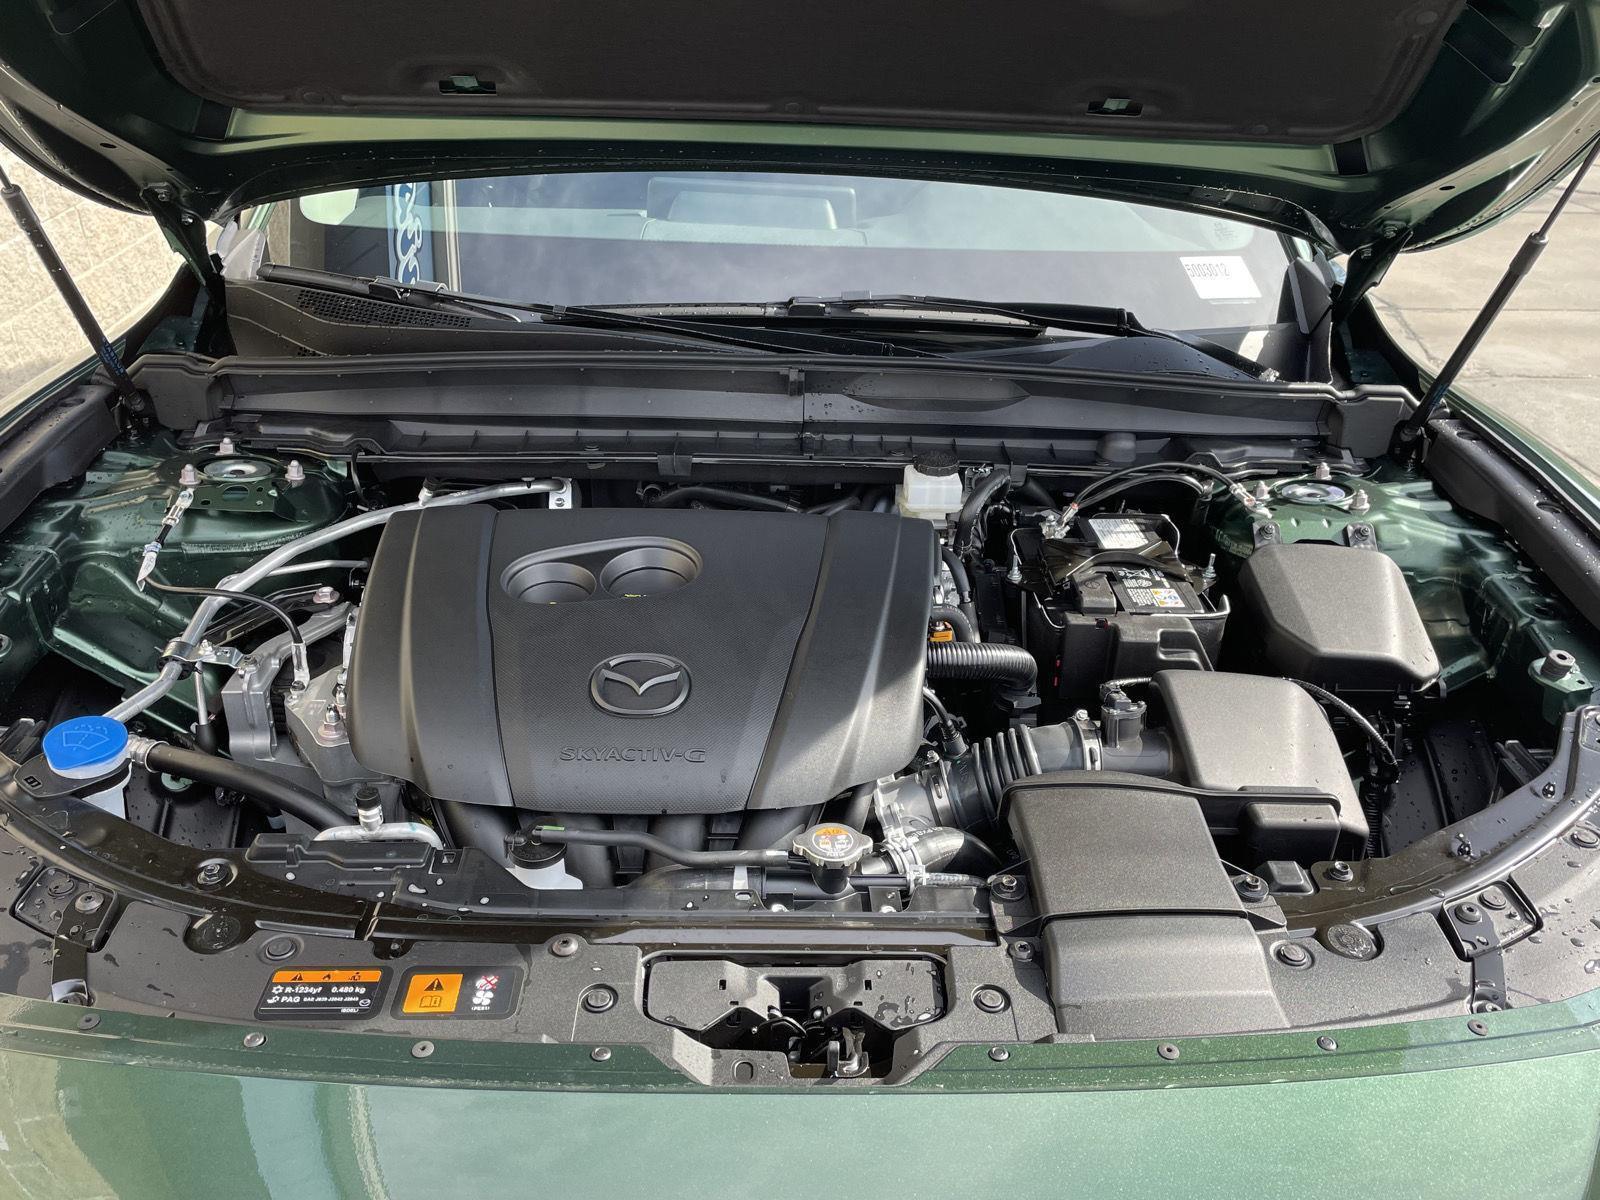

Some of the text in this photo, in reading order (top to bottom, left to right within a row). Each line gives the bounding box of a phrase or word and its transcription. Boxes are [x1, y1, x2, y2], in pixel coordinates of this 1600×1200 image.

[1184, 263, 1231, 277] 5003012
[560, 746, 706, 763] SKYACTIV-G
[284, 986, 323, 994] R-1234yf
[354, 986, 367, 994] kg
